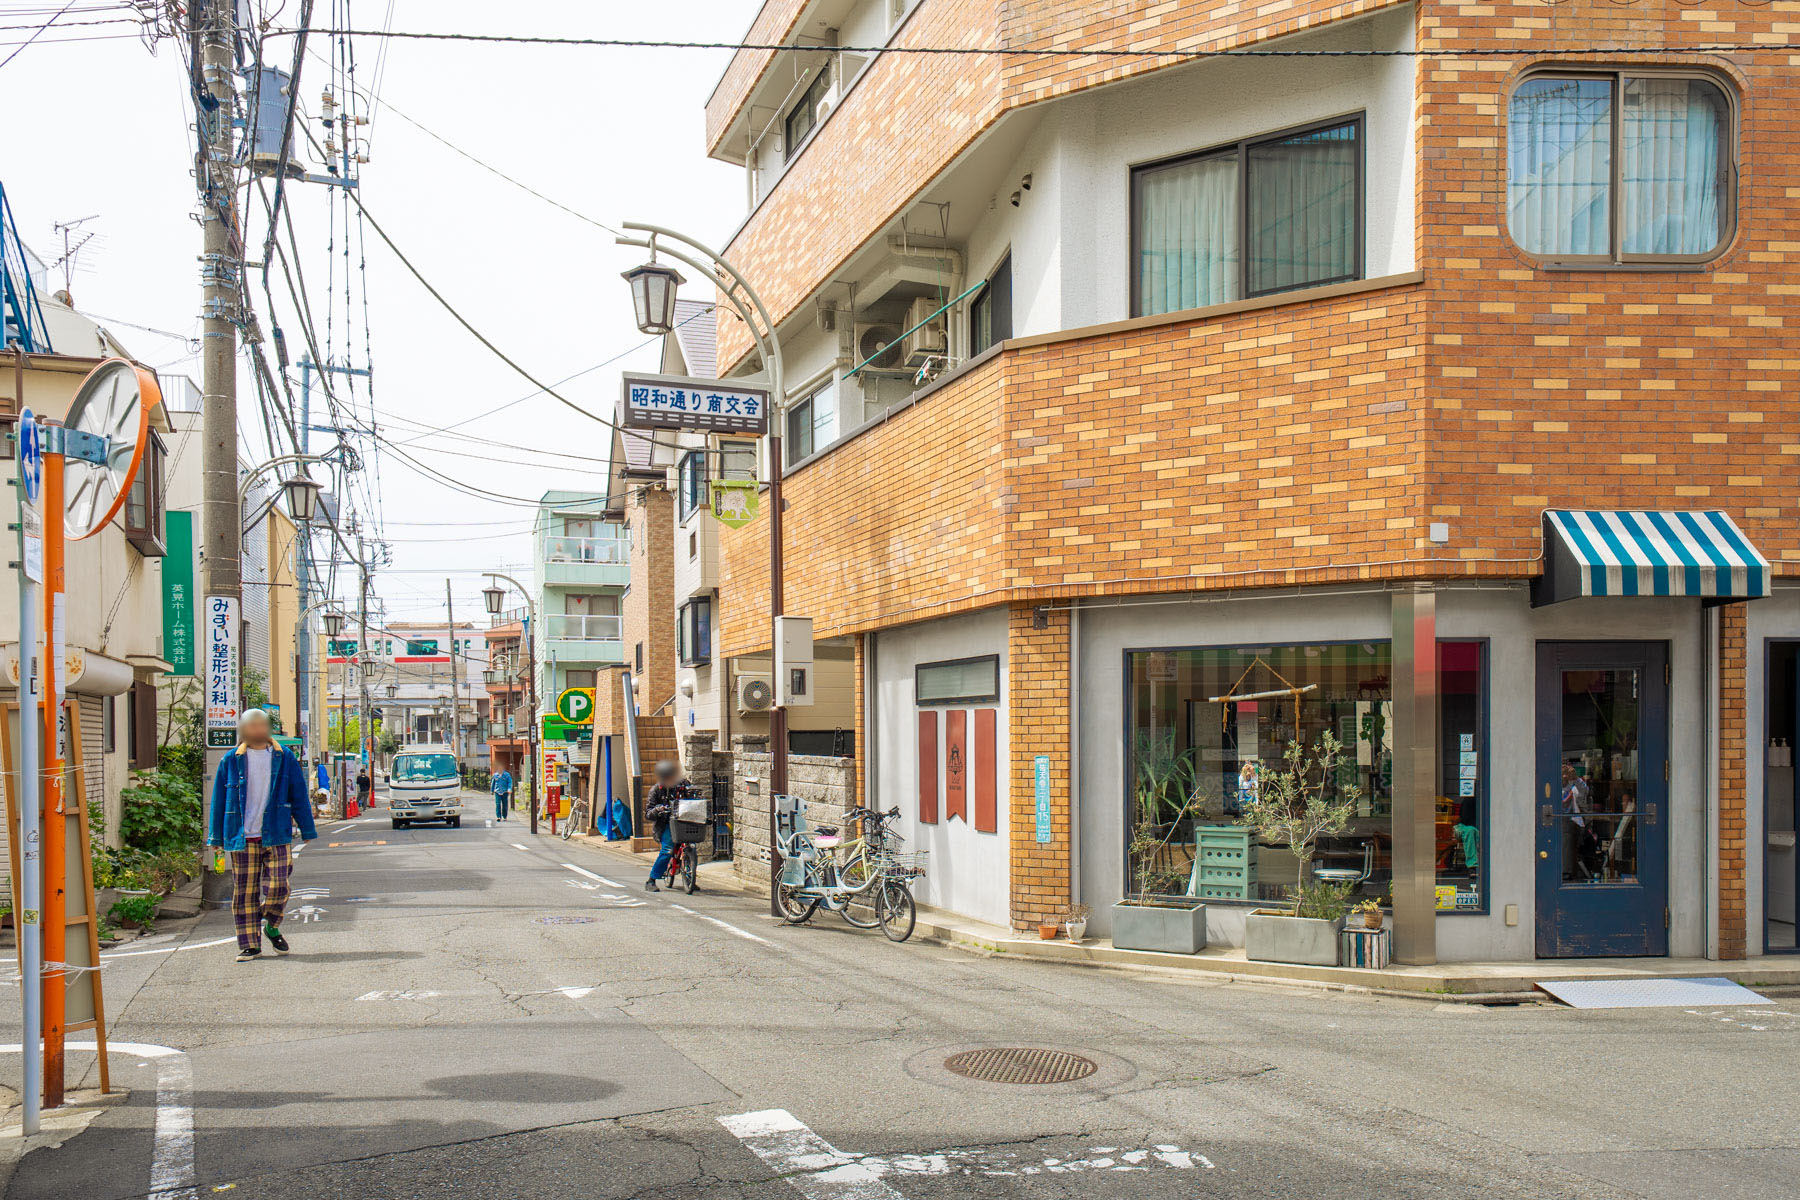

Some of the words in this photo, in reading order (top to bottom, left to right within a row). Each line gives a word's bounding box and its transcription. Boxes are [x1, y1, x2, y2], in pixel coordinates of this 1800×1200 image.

[632, 388, 760, 415] 昭和通り商交会
[212, 598, 230, 706] みずい整形外科
[569, 695, 588, 718] P
